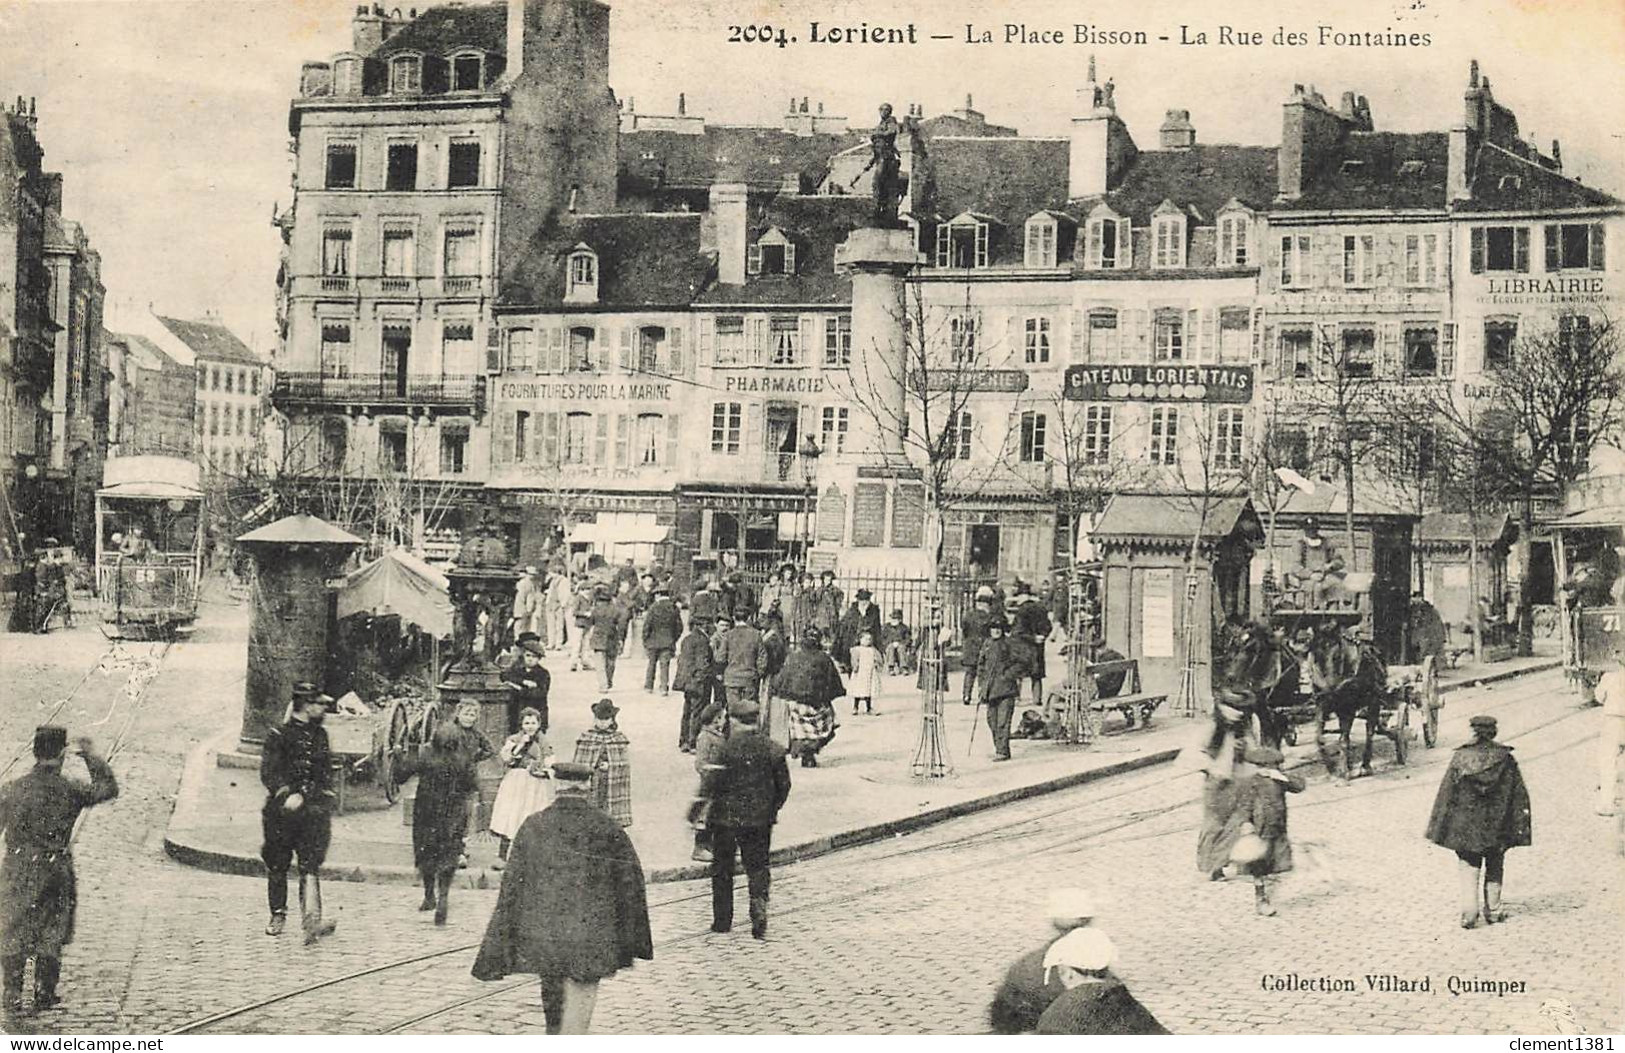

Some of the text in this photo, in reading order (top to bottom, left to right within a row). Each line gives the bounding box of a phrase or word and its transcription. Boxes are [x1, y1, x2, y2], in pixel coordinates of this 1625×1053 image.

[1488, 278, 1604, 294] LIBRAIRIE
[726, 376, 825, 393] PHARMACIE
[1071, 367, 1249, 389] GATEAU LORIENTAIS
[501, 383, 672, 400] FOURNITURES POUR LA MARINE
